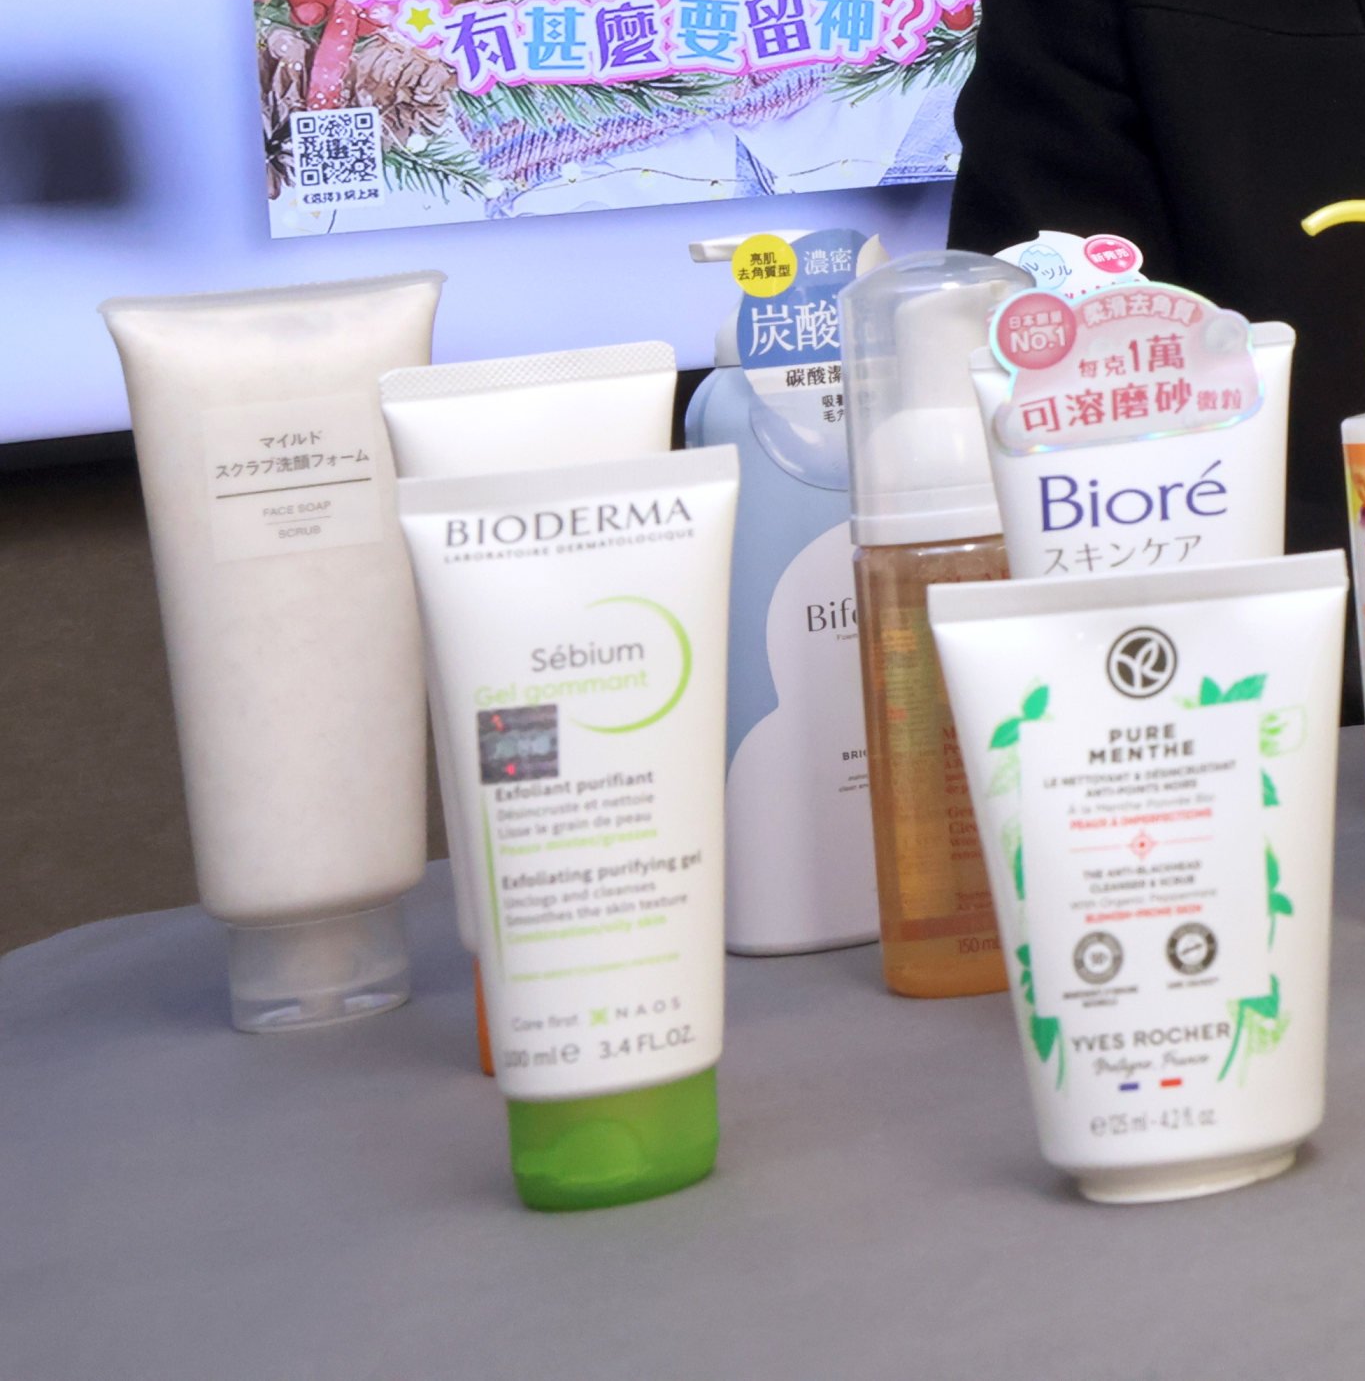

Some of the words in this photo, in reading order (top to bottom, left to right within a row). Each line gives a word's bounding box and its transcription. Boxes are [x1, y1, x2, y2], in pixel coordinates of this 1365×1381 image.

[738, 264, 791, 281] 去角質型
[750, 252, 776, 265] 亮肌
[803, 248, 852, 275] 濃密
[1010, 325, 1067, 354] No.1
[1079, 334, 1185, 379] 每克1萬
[259, 431, 322, 449] マイルド
[216, 449, 369, 479] スクラブ洗顔フォーム
[262, 506, 294, 517] FACE
[298, 501, 331, 514] SOAP
[1039, 460, 1228, 533] Bioré
[278, 525, 321, 539] SCRUB
[446, 497, 692, 548] BIODERMA
[445, 547, 550, 564] LABORATOIRE
[557, 528, 695, 554] DERMATOLOGIQUE
[1044, 535, 1201, 576] スキンケア
[531, 641, 644, 672] Sébium
[474, 684, 517, 708] Gel
[524, 670, 649, 706] gommant
[1109, 724, 1176, 743] PURE
[1088, 741, 1194, 765] MENTHE
[495, 782, 571, 803] Exfoliant
[576, 771, 655, 794] purifiant
[502, 867, 593, 891] Exfoliating
[597, 854, 676, 880] purifying
[681, 849, 702, 869] gel
[599, 1038, 631, 1060] 3.4
[1072, 1033, 1125, 1051] YVES
[1133, 1022, 1231, 1047] ROCHER
